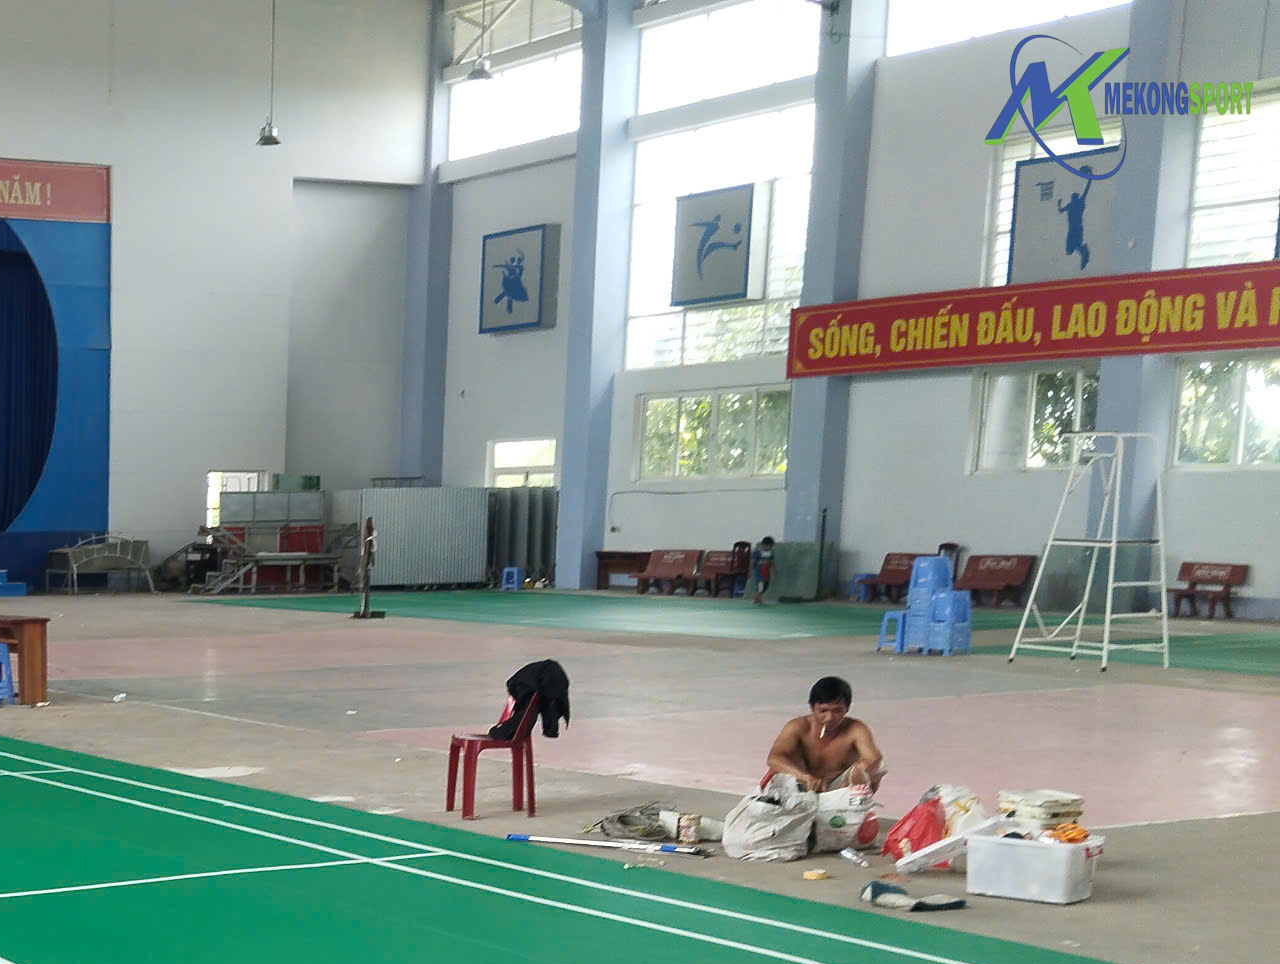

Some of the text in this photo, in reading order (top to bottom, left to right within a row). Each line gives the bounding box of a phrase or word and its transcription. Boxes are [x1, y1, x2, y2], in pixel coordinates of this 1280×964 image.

[808, 313, 881, 360] SỐNG,
[889, 303, 969, 353] CHIẾN
[976, 296, 1042, 346] ĐẤU,
[1051, 301, 1107, 341] LAO
[1115, 289, 1205, 343] ĐỘNG
